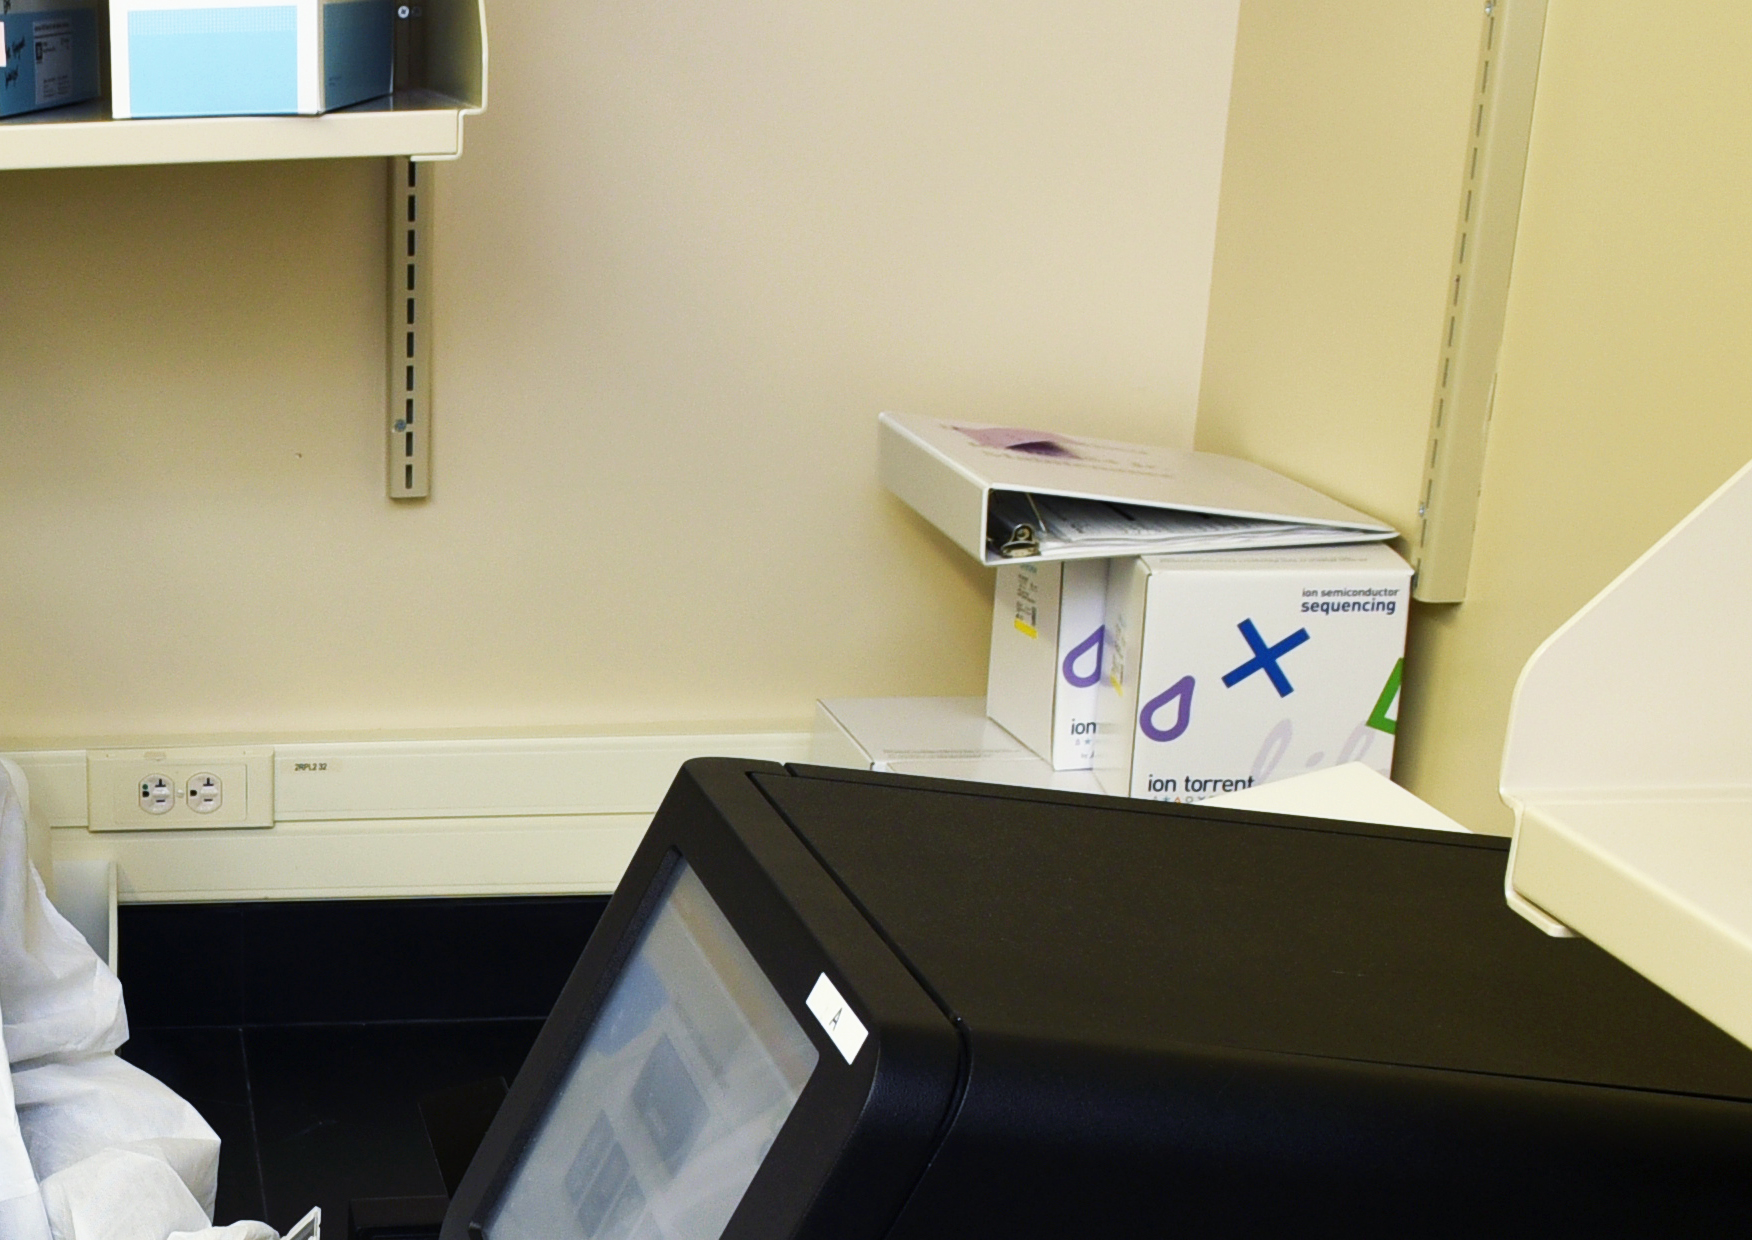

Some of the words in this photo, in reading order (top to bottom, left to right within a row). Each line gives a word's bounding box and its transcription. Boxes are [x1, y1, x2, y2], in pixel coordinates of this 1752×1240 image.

[1302, 588, 1318, 597] ion
[1321, 587, 1400, 597] semiconductor
[1301, 597, 1396, 616] sequencing
[1071, 718, 1097, 735] ion
[1148, 774, 1177, 792] ion
[1184, 775, 1255, 792] torrent
